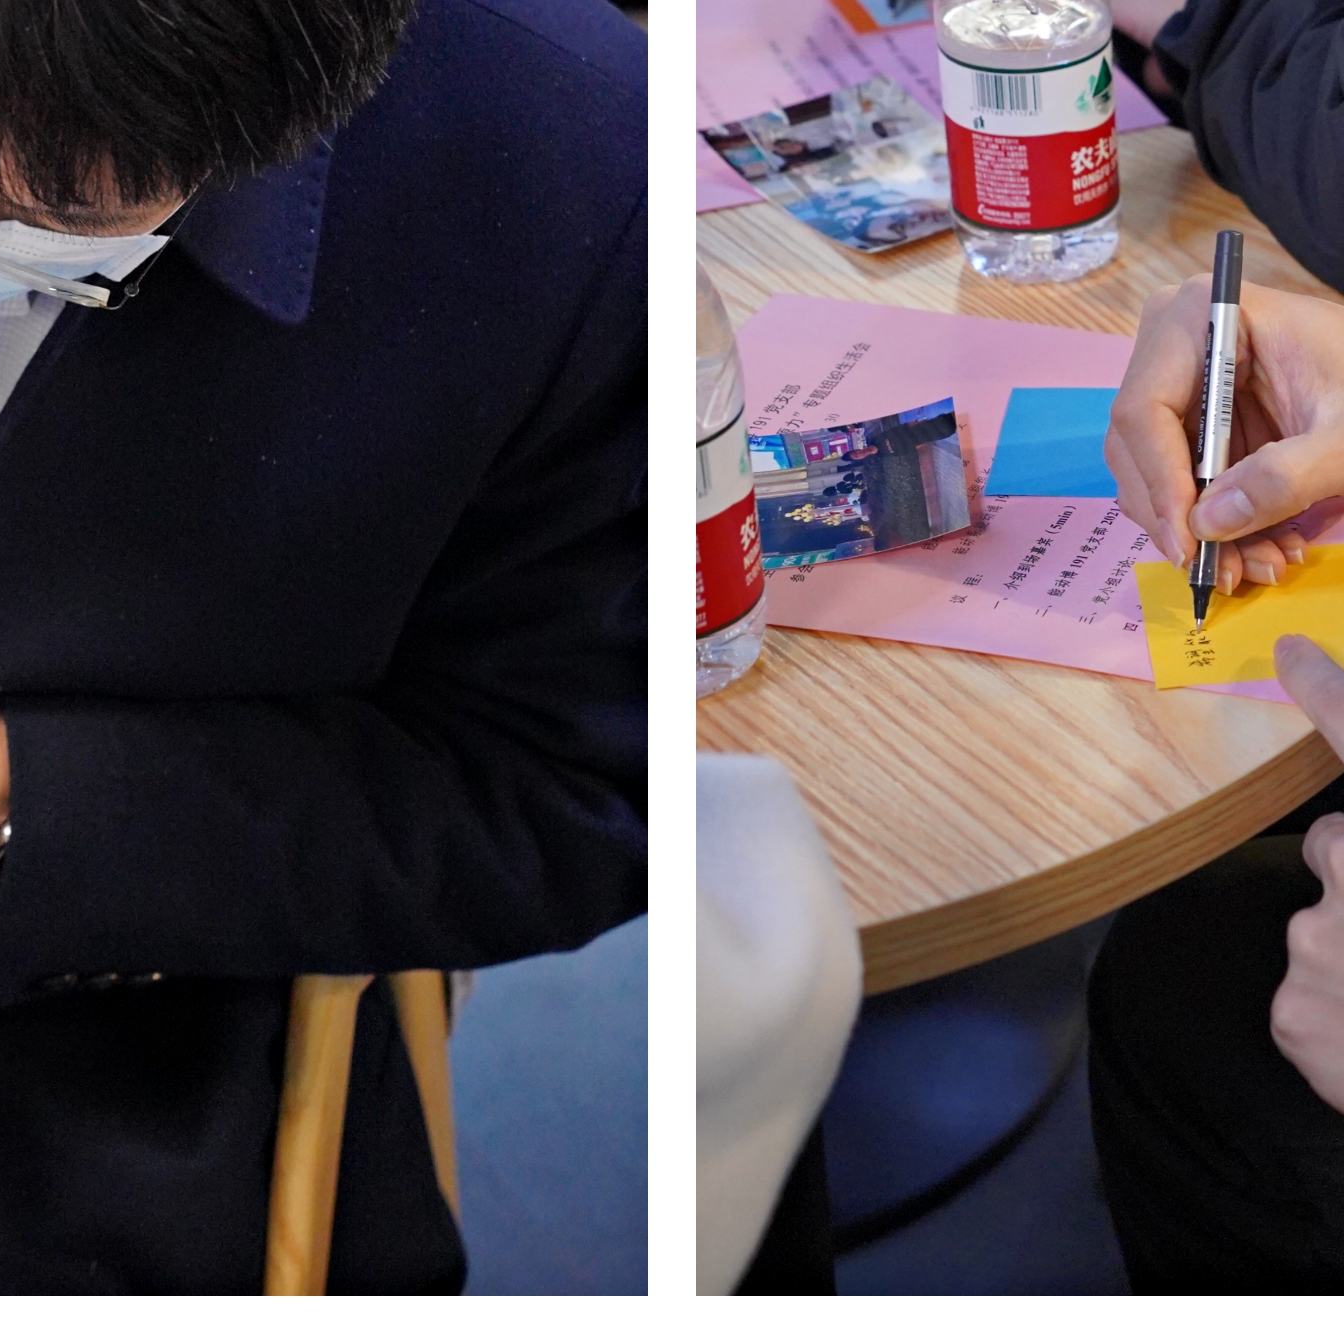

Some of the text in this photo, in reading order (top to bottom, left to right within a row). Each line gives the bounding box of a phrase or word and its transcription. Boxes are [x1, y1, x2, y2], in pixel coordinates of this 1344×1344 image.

[802, 341, 872, 410] 专题组织生活会
[750, 383, 802, 432] 191 党支部
[1047, 568, 1079, 597] 能动博
[1069, 554, 1089, 570] 191
[1087, 525, 1109, 556] 党支部
[1091, 554, 1136, 605] 党小组讨论：
[950, 593, 967, 605] 议
